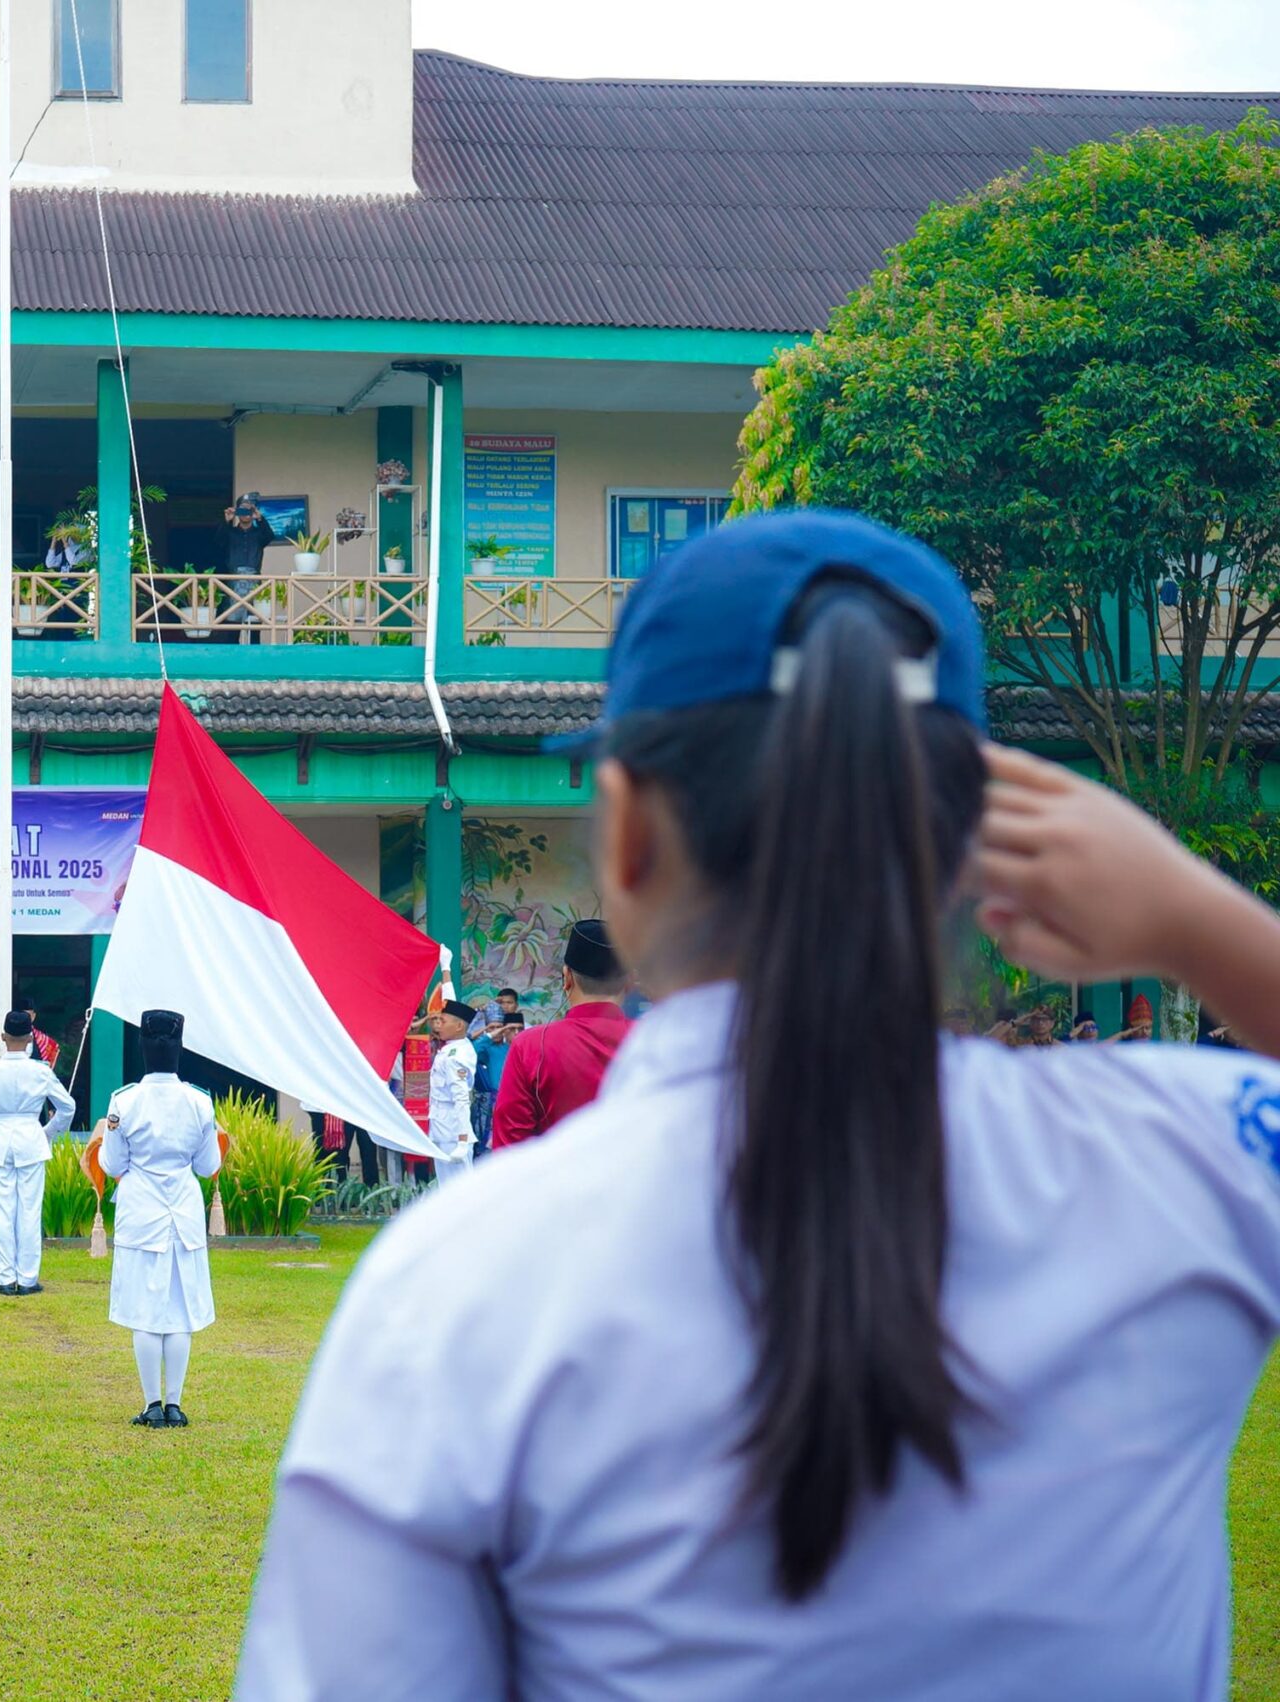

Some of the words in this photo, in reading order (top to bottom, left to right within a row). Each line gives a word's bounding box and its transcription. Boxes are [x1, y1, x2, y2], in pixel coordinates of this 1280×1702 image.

[524, 440, 551, 448] MALU
[102, 812, 130, 820] MEDAN
[59, 860, 103, 879] 2025
[26, 889, 45, 897] Untuk
